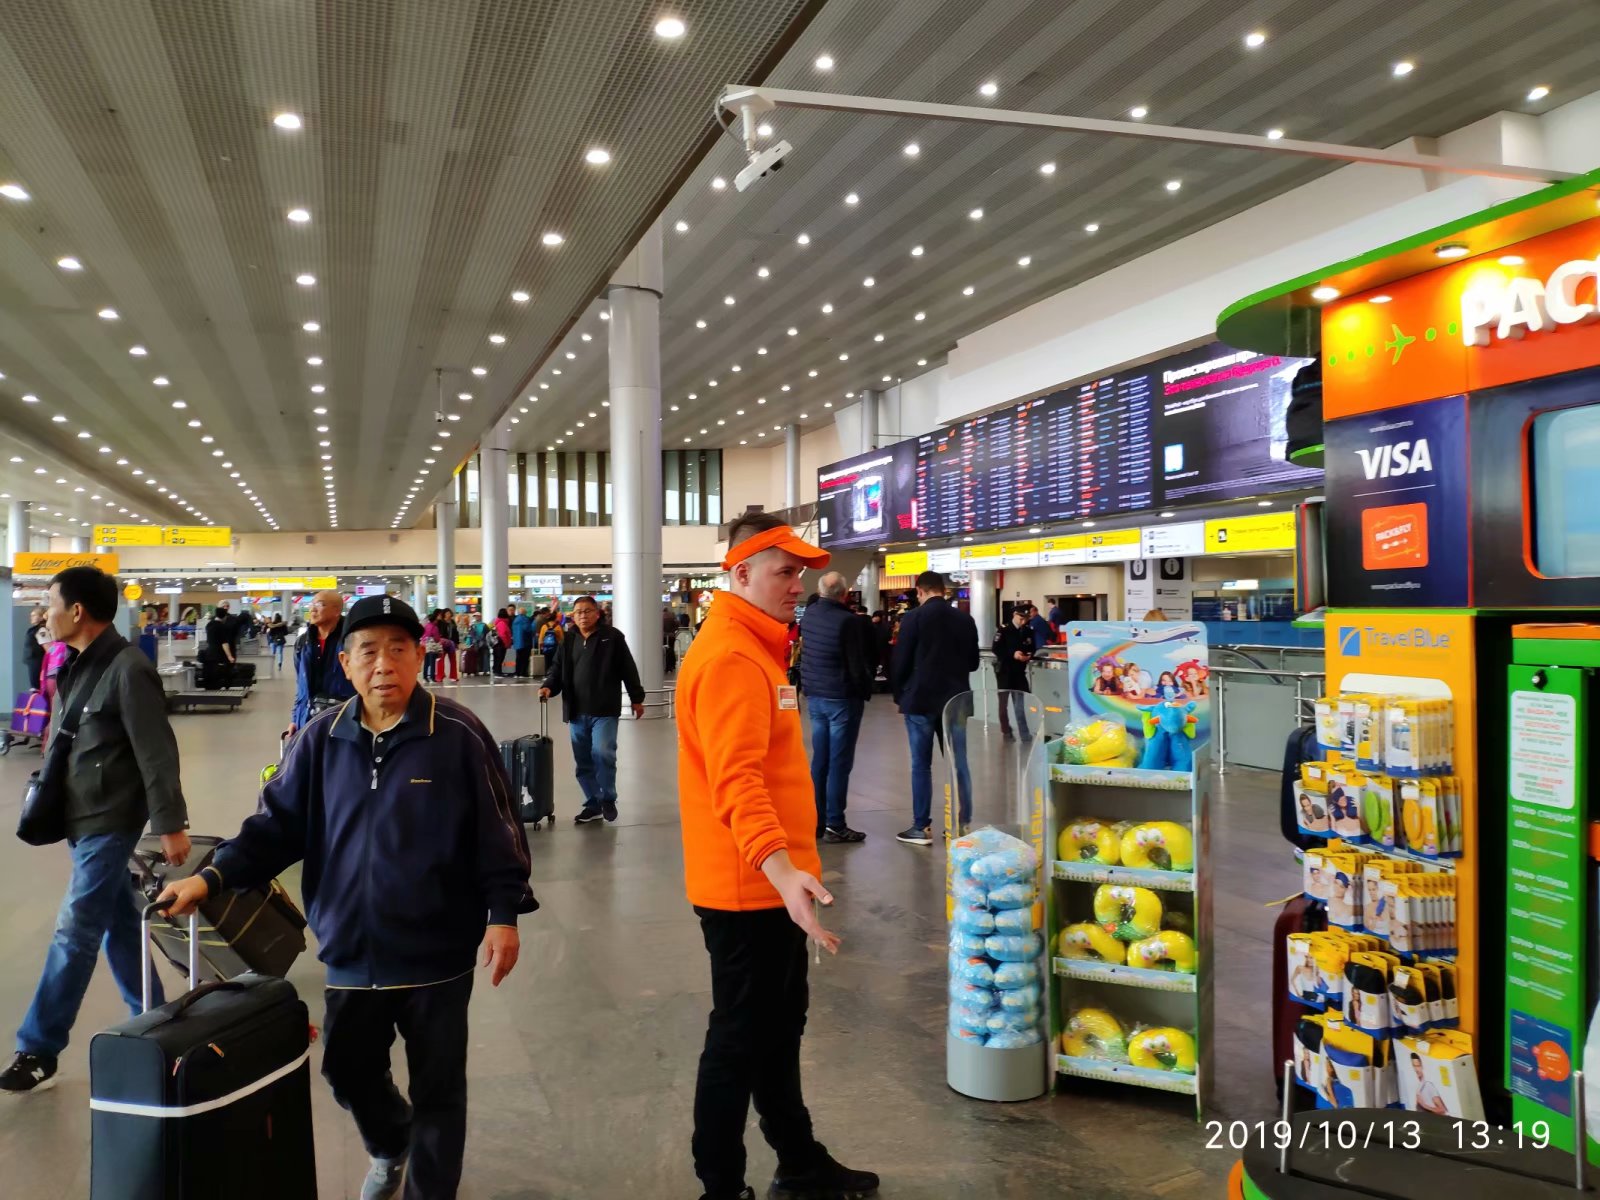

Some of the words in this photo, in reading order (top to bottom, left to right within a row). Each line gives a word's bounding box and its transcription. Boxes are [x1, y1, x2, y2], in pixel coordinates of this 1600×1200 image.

[1460, 254, 1600, 347] PAC
[1354, 438, 1433, 480] VISA
[31, 557, 65, 569] Upper
[1364, 626, 1412, 647] Travel
[1413, 627, 1450, 648] Blue
